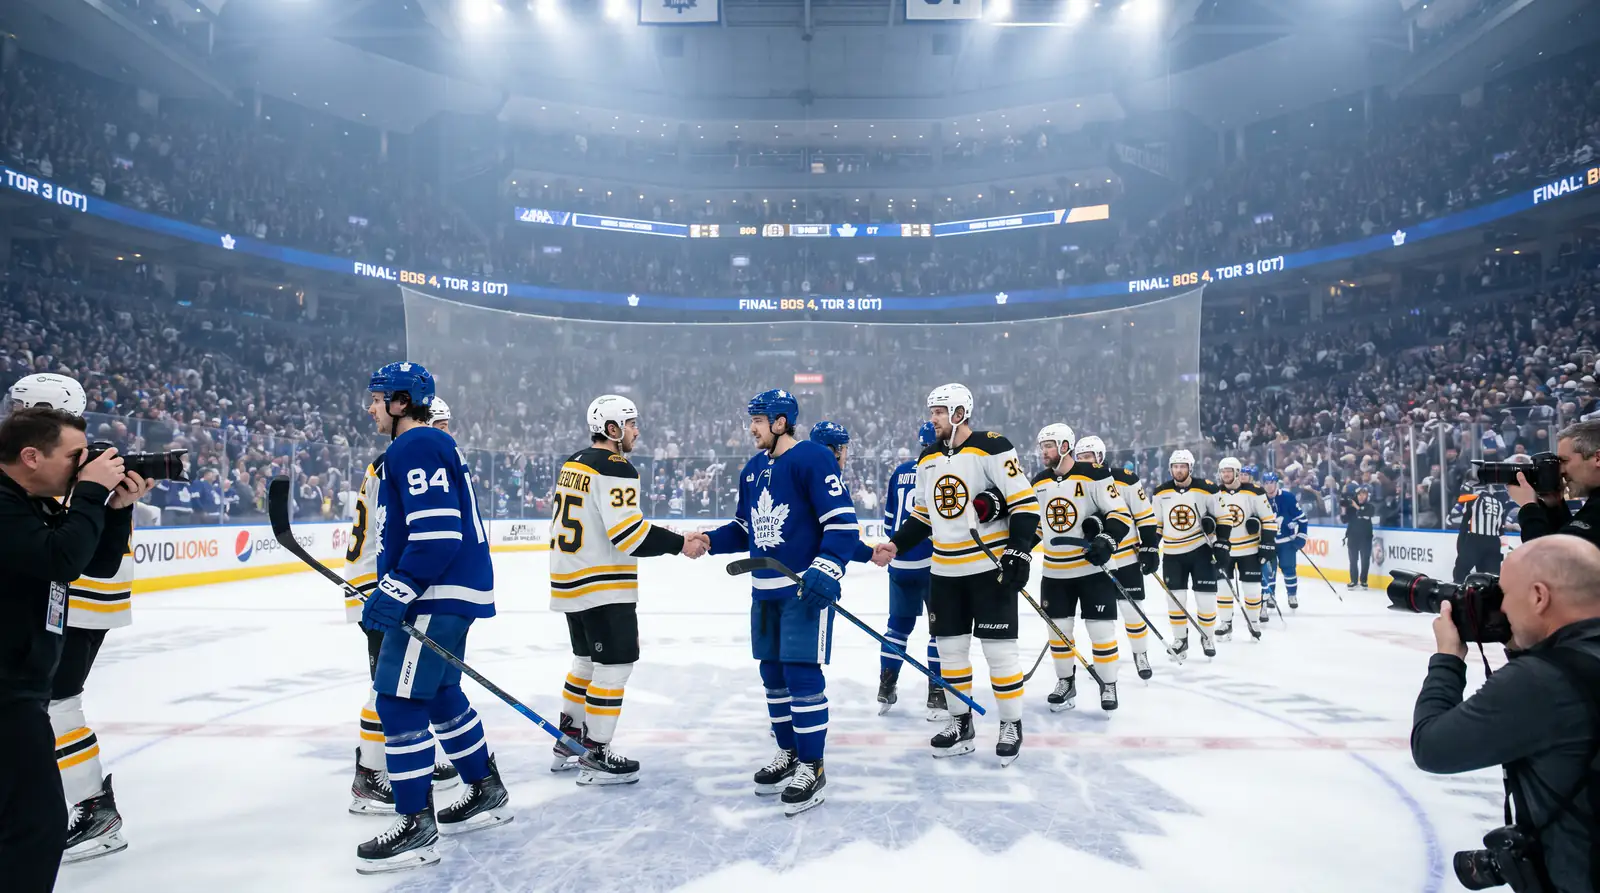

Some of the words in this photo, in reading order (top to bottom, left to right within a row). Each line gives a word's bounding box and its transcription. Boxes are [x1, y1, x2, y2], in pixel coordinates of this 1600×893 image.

[5, 169, 39, 195] TOR
[42, 183, 53, 199] 3
[57, 187, 87, 212] (OT)
[1533, 175, 1583, 205] FINAL:
[1587, 167, 1600, 185] B
[354, 262, 397, 281] FINAL:
[400, 270, 426, 285] BOS
[429, 275, 441, 288] 4,
[443, 277, 468, 291] TOR
[471, 280, 480, 292] 3
[482, 281, 508, 296] (OT)
[1128, 276, 1170, 292] FINAL:
[1173, 272, 1198, 287] BOS
[1201, 270, 1213, 283] 4,
[1216, 264, 1242, 280] TOR
[1245, 262, 1254, 275] 3
[1257, 256, 1284, 274] (OT)
[739, 299, 778, 309] FINAL:
[780, 299, 804, 309] BOS
[807, 299, 819, 311] 4,
[820, 299, 845, 309] TOR
[847, 299, 856, 309] 3
[858, 298, 882, 311] (OT)
[407, 467, 450, 496] 94
[1074, 482, 1085, 497] A
[610, 487, 637, 508] 32
[756, 531, 775, 539] LEAFS
[811, 560, 841, 577] CCM
